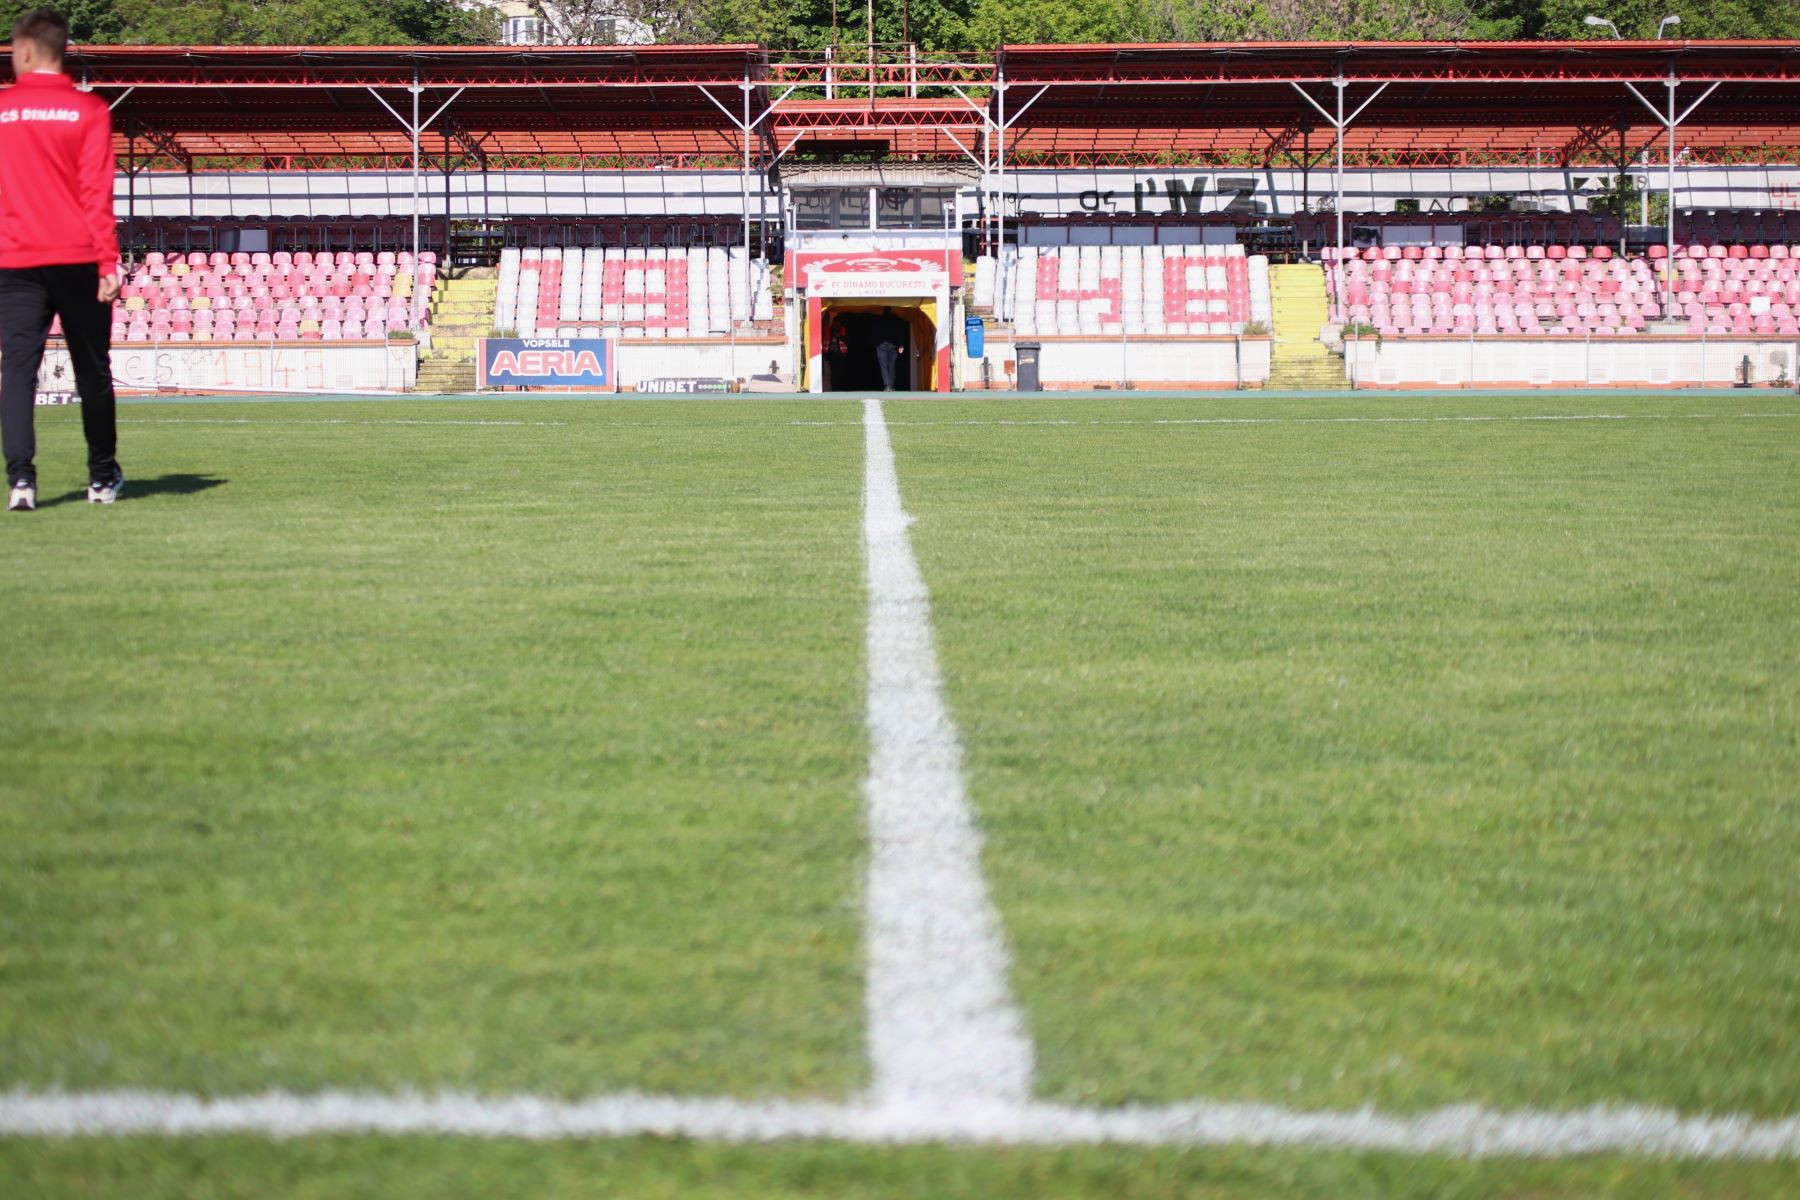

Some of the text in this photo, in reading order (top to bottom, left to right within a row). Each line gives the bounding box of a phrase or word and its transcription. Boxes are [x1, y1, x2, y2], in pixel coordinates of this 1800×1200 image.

[22, 108, 80, 122] DINAMO
[831, 281, 842, 289] FC
[843, 281, 877, 289] DINAMO
[523, 339, 571, 348] VOPSELE
[489, 350, 603, 376] AERIA
[636, 380, 697, 393] UNIBET
[35, 393, 72, 405] BET
